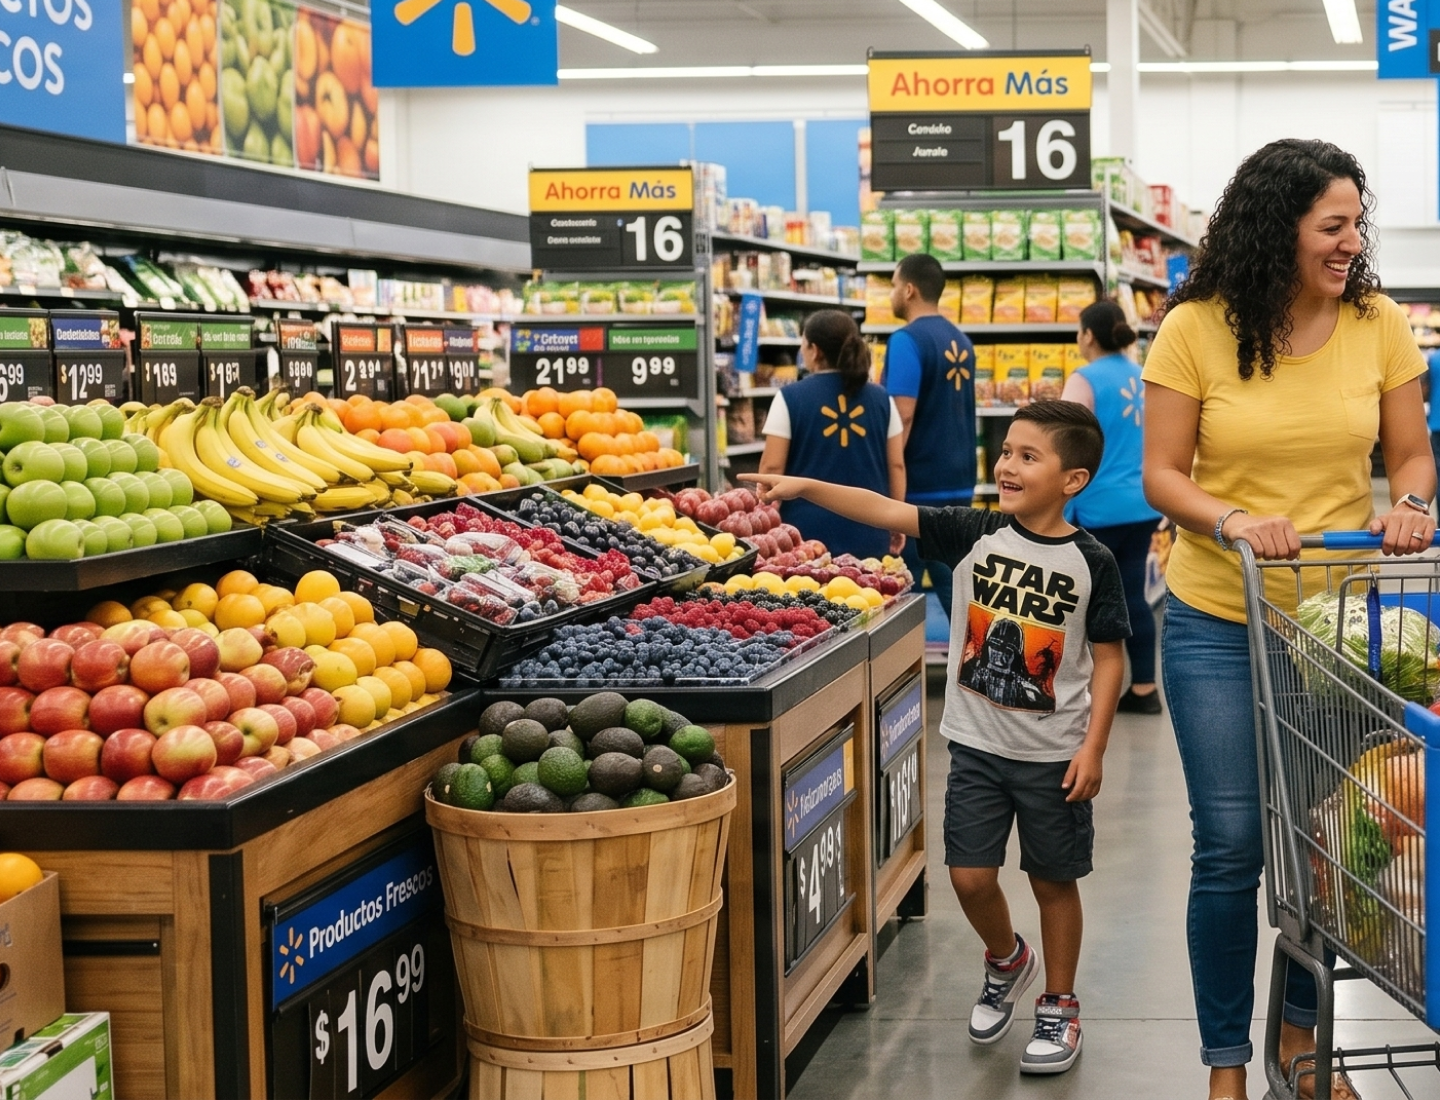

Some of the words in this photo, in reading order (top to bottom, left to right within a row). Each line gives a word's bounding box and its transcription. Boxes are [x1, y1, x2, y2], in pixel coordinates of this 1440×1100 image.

[890, 72, 994, 96] Ahorra
[1005, 69, 1068, 95] Más
[998, 119, 1077, 180] 16
[545, 182, 621, 200] Ahorra
[629, 180, 676, 199] Más
[626, 215, 684, 262] 16
[973, 553, 1079, 604] STAR
[973, 573, 1076, 626] WARS
[309, 895, 383, 959] Productos
[386, 865, 434, 912] Frescos
